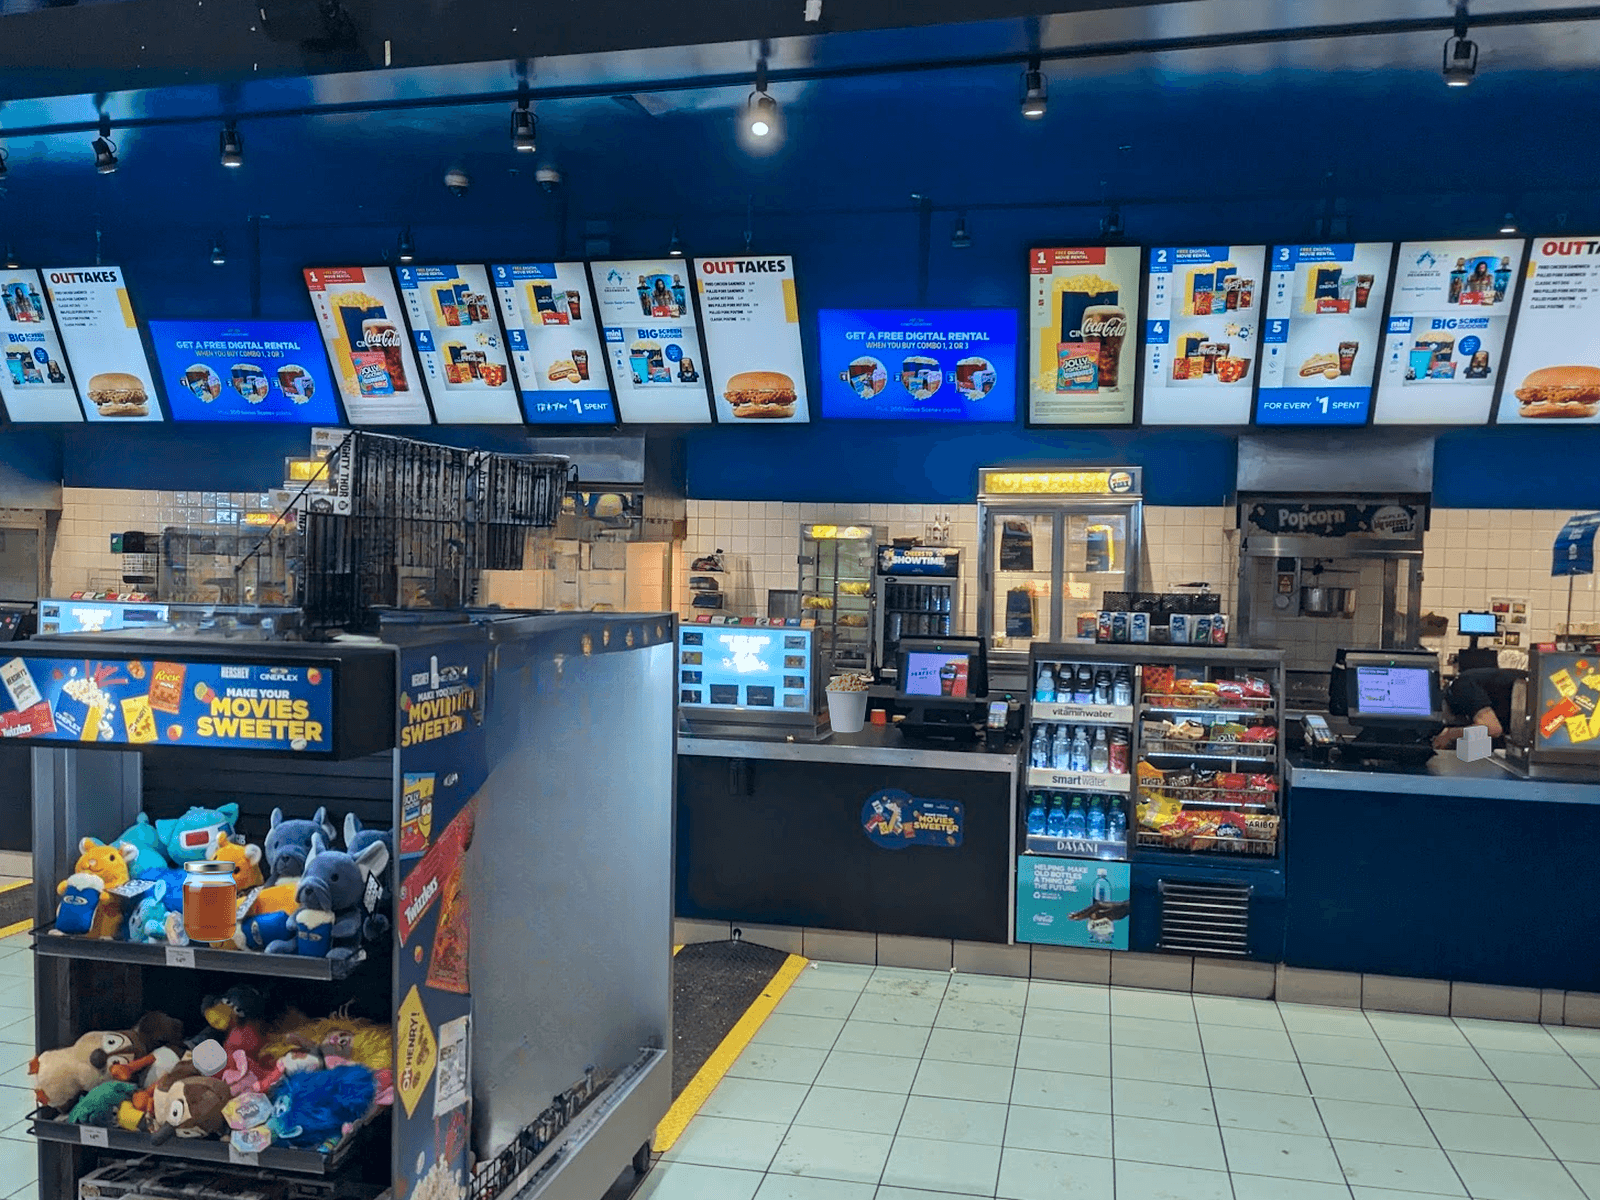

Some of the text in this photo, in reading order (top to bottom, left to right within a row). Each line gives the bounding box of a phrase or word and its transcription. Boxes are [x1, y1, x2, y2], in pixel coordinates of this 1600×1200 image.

[1037, 251, 1047, 264] 1
[1157, 249, 1167, 263] 2
[1279, 248, 1290, 260] 3
[497, 266, 506, 278] 3
[702, 260, 786, 274] OUTTAKES
[50, 271, 117, 284] OUTTAKES
[309, 271, 319, 282] 1
[401, 268, 411, 280] 2
[1153, 321, 1163, 334] 4
[1272, 321, 1282, 333] 5
[1391, 319, 1411, 327] mini
[1431, 319, 1458, 330] BIG
[8, 333, 26, 342] BIG
[419, 332, 428, 343] 4
[513, 331, 522, 342] 5
[637, 329, 658, 339] BIG
[845, 331, 990, 341] GET A FREE DIGITAL RENTAL
[176, 341, 193, 349] GET
[228, 342, 263, 350] DIGITAL
[264, 342, 300, 350] RENTAL
[1065, 357, 1088, 369] JOLLY
[339, 473, 350, 497] THOR
[1278, 508, 1346, 530] Popcorn
[892, 556, 946, 565] SHOWTIME
[260, 673, 298, 681] CINEPLEX
[226, 688, 290, 699] MAKE YOUR
[210, 697, 309, 720] MOVIES
[1052, 708, 1114, 718] vitaminwater
[197, 716, 323, 741] SWEETER
[919, 816, 954, 824] MOVIES
[1245, 820, 1274, 829] ARIBO
[914, 821, 959, 832] SWEETER
[1056, 841, 1098, 853] DASANI
[1034, 864, 1088, 874] HELPING MAKE
[1041, 877, 1063, 885] THING
[1051, 871, 1082, 880] BOTTLES
[402, 1011, 420, 1091] OH HENRY!
